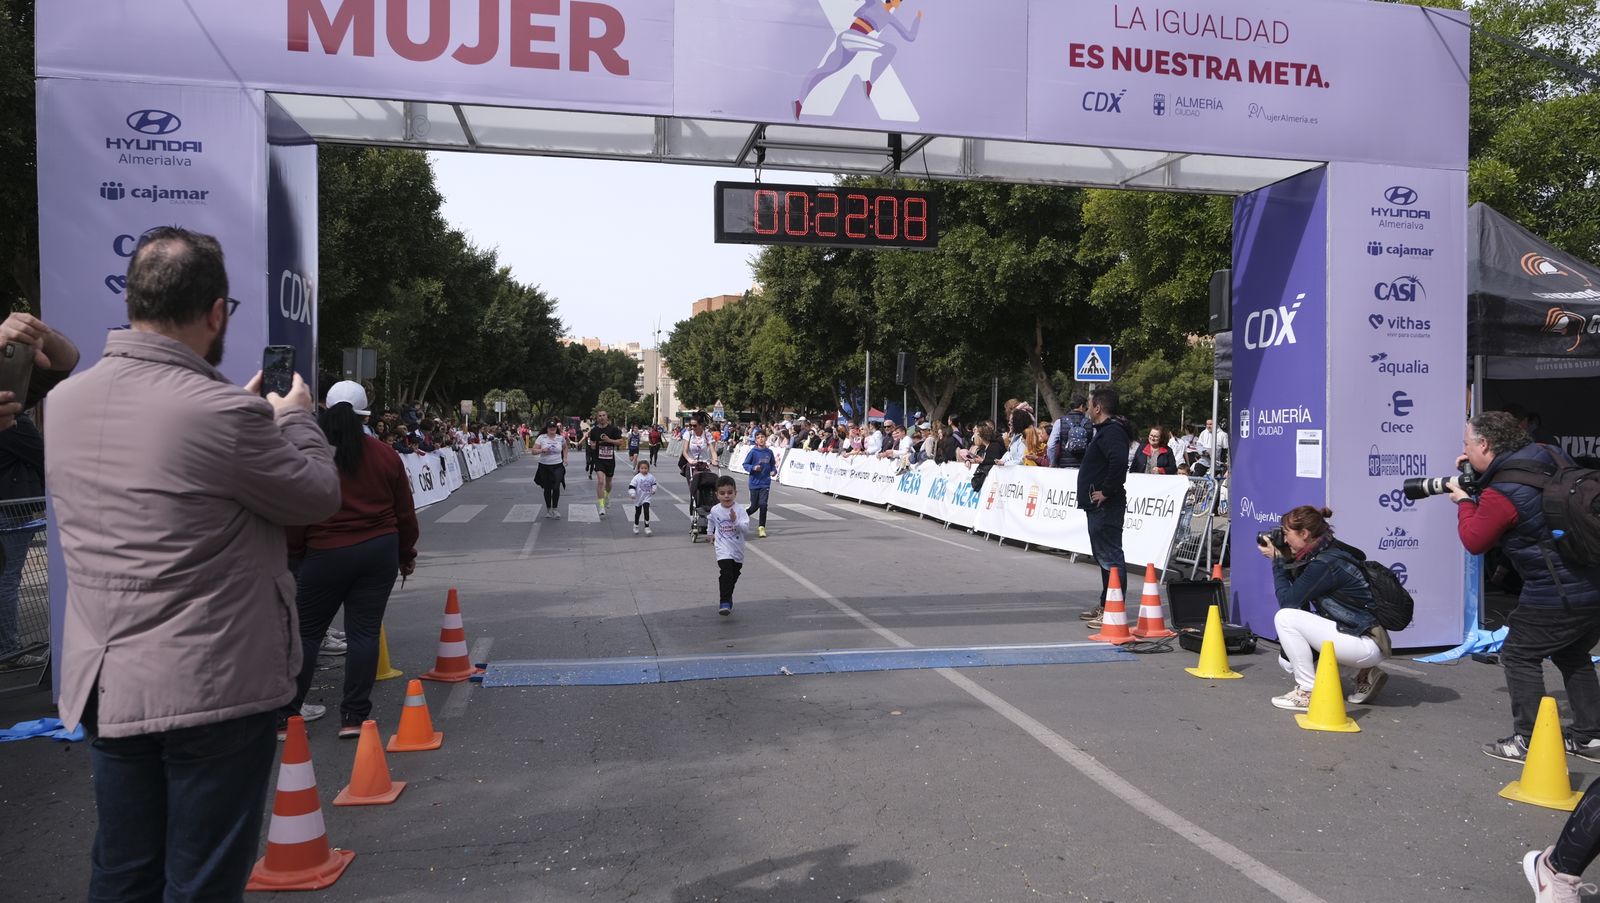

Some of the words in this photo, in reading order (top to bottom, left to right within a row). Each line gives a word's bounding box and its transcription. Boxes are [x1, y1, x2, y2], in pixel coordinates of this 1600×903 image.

[1114, 4, 1146, 31] LA
[1156, 8, 1289, 45] IGUALDAD
[287, 0, 630, 76] MUJER
[1069, 42, 1105, 69] ES
[1112, 46, 1242, 82] NUESTRA
[1248, 60, 1330, 89] META.
[1082, 89, 1127, 113] CDX
[1175, 96, 1224, 111] ALMERÍA
[106, 137, 202, 153] HYUNDAI
[118, 153, 192, 167] Almerialva
[131, 185, 209, 202] cajamar
[754, 189, 927, 241] 00:22:08
[1371, 207, 1431, 220] HYUNDAI
[1379, 219, 1424, 231] Almerialva
[1386, 243, 1434, 258] cajamar
[280, 269, 312, 325] CDX
[1374, 282, 1416, 302] CASI
[1244, 293, 1306, 350] CDX
[1387, 316, 1431, 330] vithas
[1378, 359, 1430, 377] aqualia
[1258, 405, 1312, 424] ALMERÍA
[1257, 426, 1284, 436] CIUDAD
[1381, 421, 1414, 433] Clece
[1399, 454, 1427, 476] CASH
[1379, 489, 1415, 512] ego
[1378, 537, 1419, 550] Lanjarón
